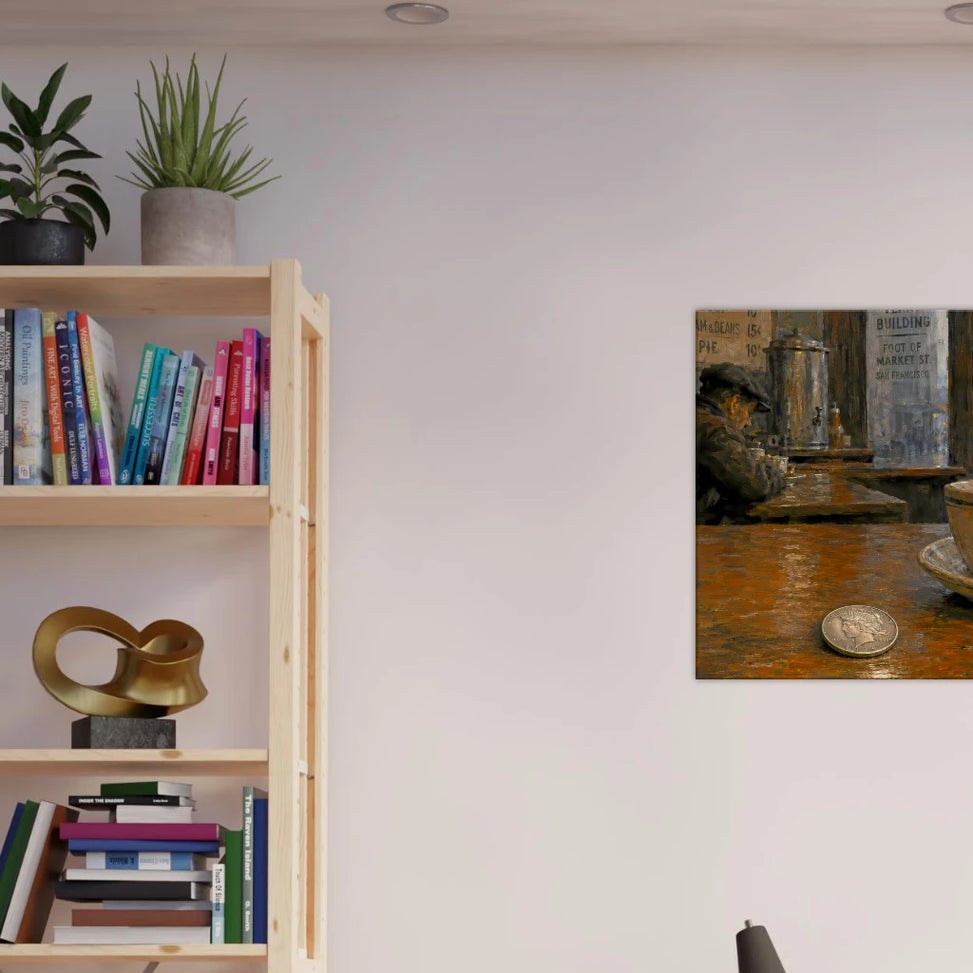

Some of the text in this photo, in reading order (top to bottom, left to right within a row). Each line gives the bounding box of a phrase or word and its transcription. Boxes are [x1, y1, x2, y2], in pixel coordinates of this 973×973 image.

[876, 316, 931, 330] BUILDING
[17, 325, 32, 385] Oil Paintings
[47, 346, 55, 363] FINE
[70, 342, 78, 358] Find
[699, 340, 718, 354] PIE
[883, 342, 922, 353] FOOT OF
[78, 326, 92, 372] Watercolor
[86, 375, 99, 410] Portraits
[876, 355, 915, 366] MARKET
[48, 364, 56, 378] ART
[58, 343, 73, 408] ICONIC
[71, 359, 80, 383] Beauty
[49, 384, 58, 401] With
[74, 385, 81, 393] In
[229, 363, 240, 416] Parenting Skills
[49, 402, 60, 423] Digital
[52, 424, 61, 442] Tools
[79, 437, 88, 471] NORMAN
[244, 794, 252, 880] The Raven Island
